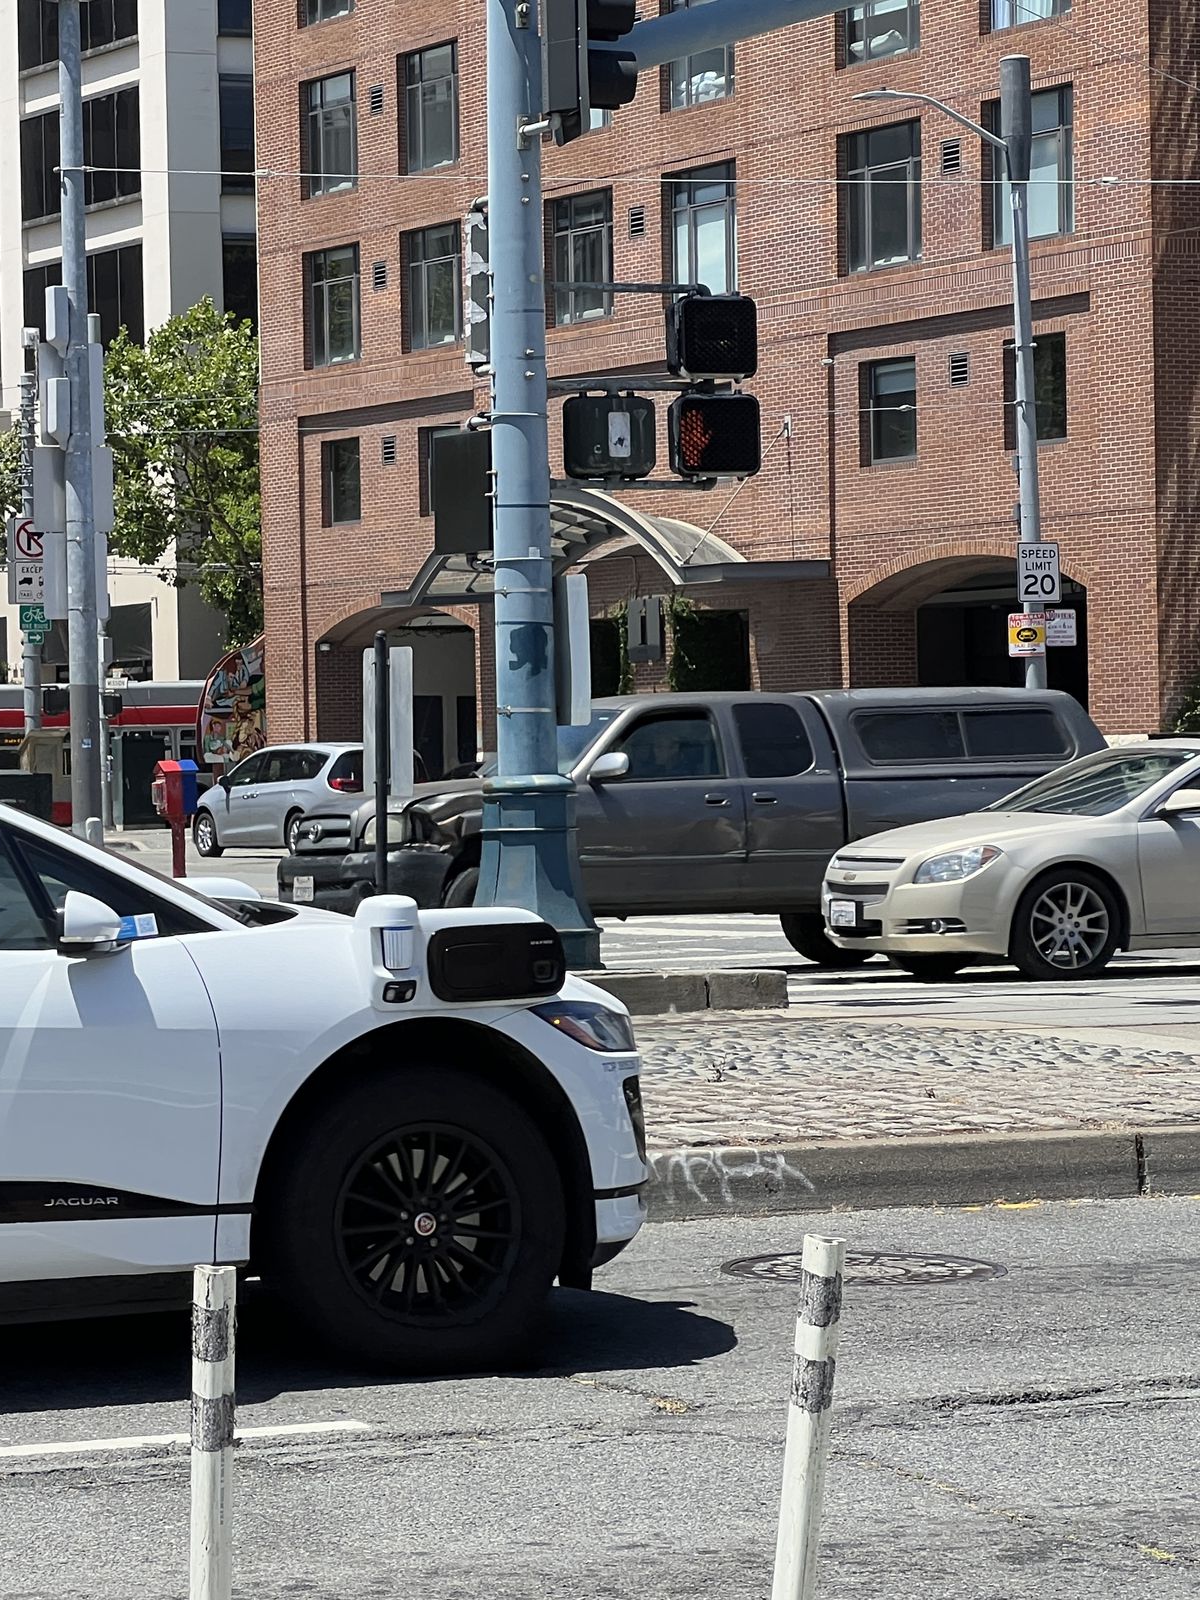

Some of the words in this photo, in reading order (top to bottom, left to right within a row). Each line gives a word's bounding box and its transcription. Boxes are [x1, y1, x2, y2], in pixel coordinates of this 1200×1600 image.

[1021, 550, 1056, 559] SPEED
[21, 566, 44, 574] EXCEP
[1025, 561, 1052, 571] LIMIT
[1024, 574, 1055, 595] 20
[1046, 610, 1056, 620] NO
[1010, 620, 1021, 628] NO
[43, 1197, 119, 1207] JAGUAR
